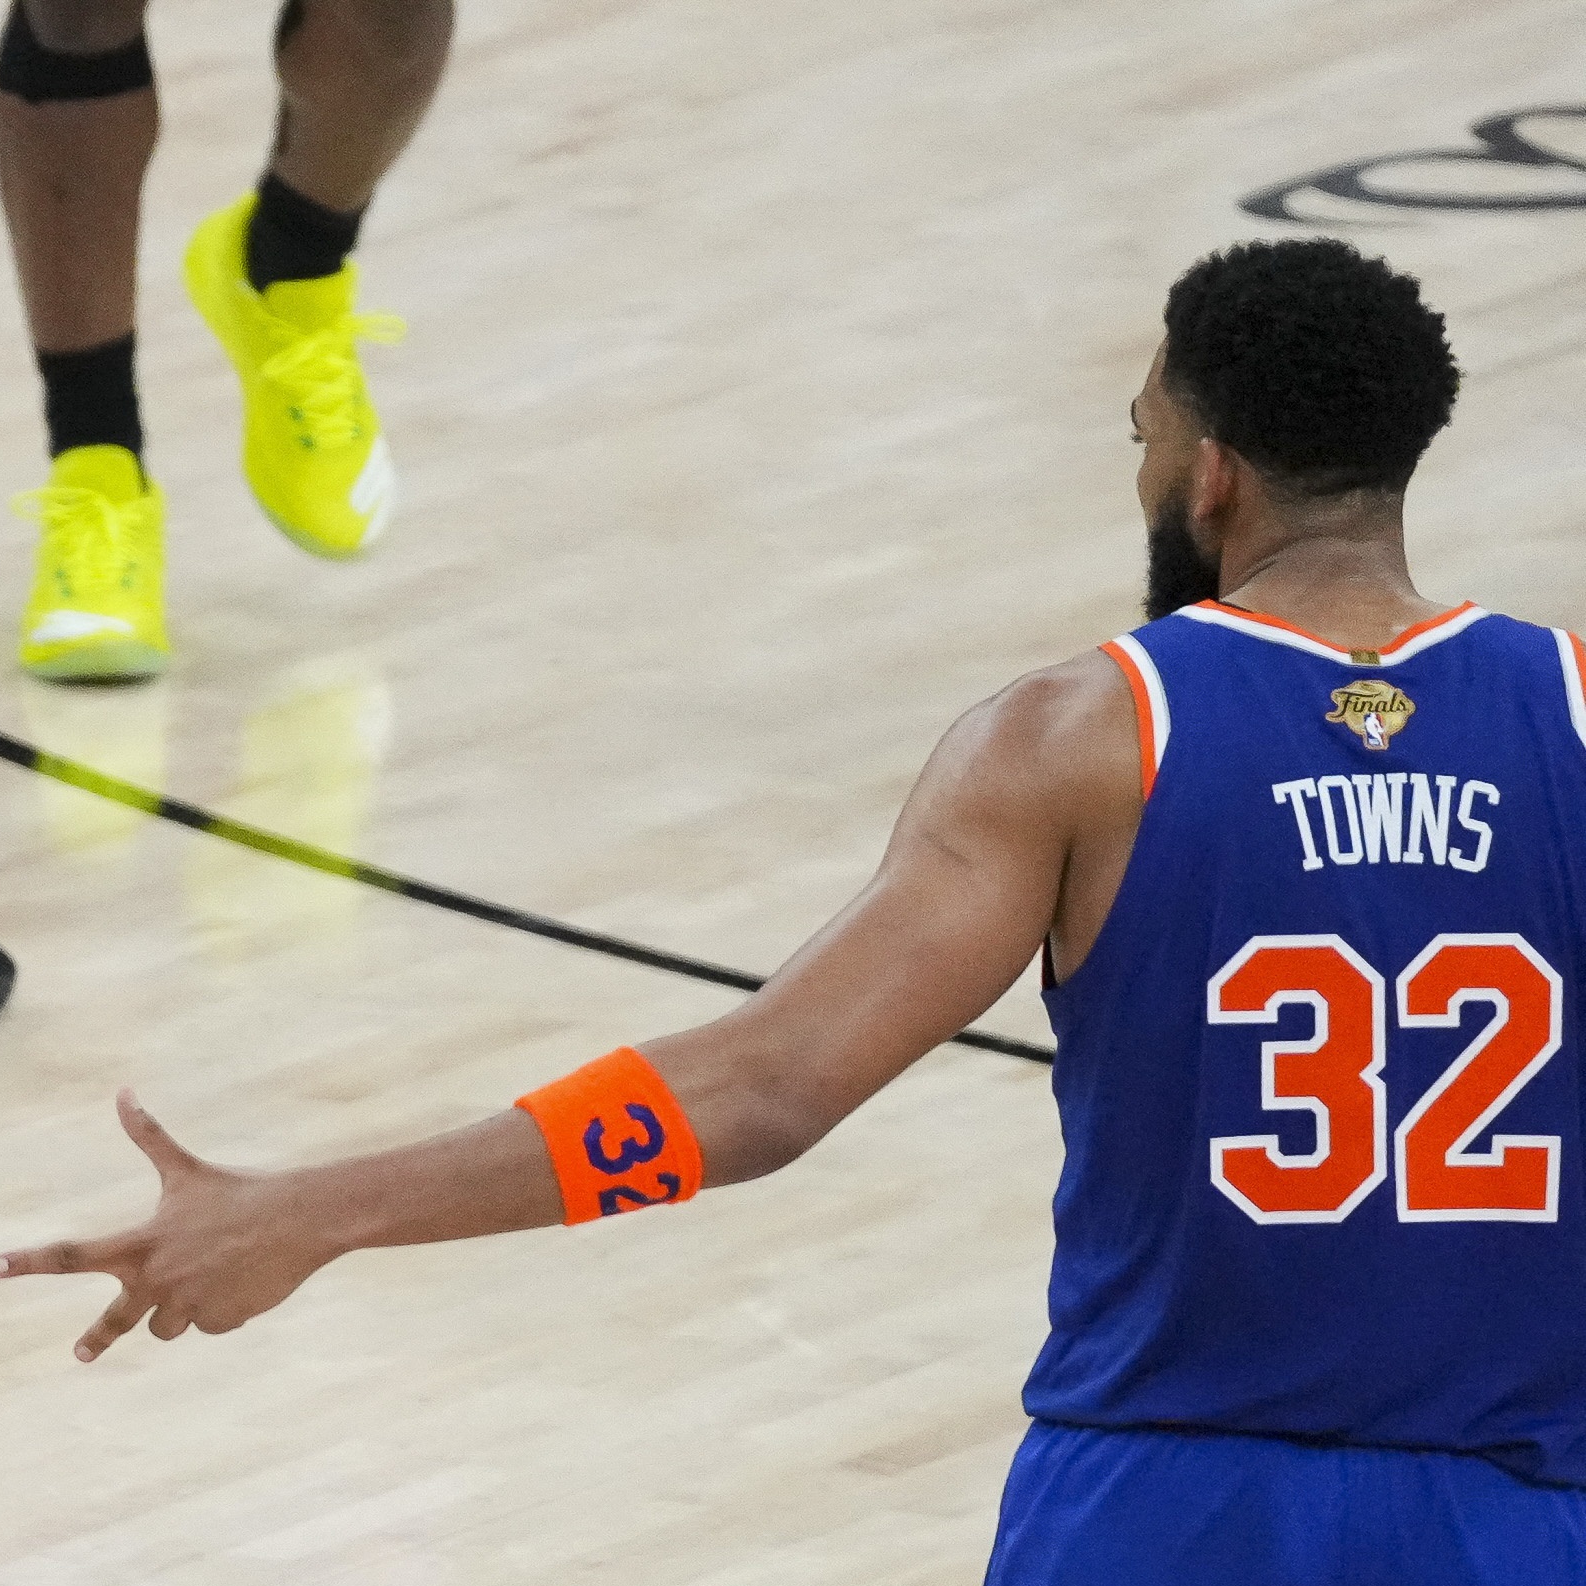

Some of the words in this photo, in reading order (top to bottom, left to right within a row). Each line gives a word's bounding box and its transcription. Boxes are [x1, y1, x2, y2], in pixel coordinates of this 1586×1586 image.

[1331, 690, 1408, 718] Finals
[1273, 772, 1500, 873] TOWNS
[1207, 933, 1563, 1225] 32
[583, 1102, 682, 1217] 32
